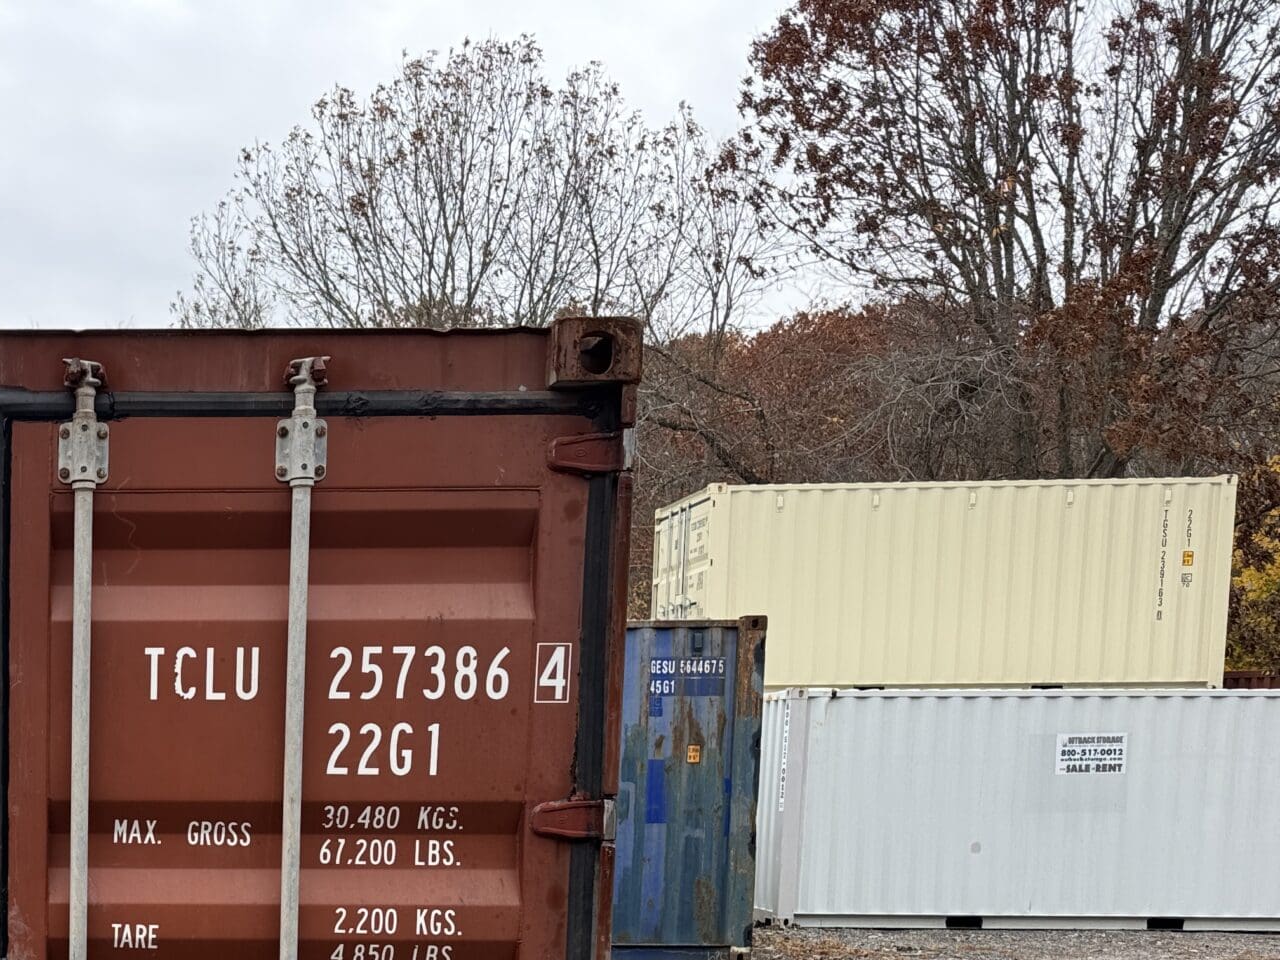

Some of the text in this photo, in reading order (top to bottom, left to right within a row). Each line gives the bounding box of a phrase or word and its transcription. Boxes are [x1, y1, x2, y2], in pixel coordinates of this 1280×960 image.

[144, 644, 567, 701] TCLU 257386 4
[650, 660, 676, 674] GESU
[650, 680, 675, 694] 45G1
[325, 722, 440, 777] 22G1
[1060, 748, 1123, 757] 800-517-0012
[1066, 764, 1091, 773] SALE
[1095, 763, 1123, 773] RENT
[417, 805, 464, 830] KGS.
[112, 819, 252, 847] MAX. GROSS
[319, 838, 461, 867] 67,200 LBS.
[334, 907, 463, 937] 2,200 KGS.
[112, 924, 159, 950] TARE
